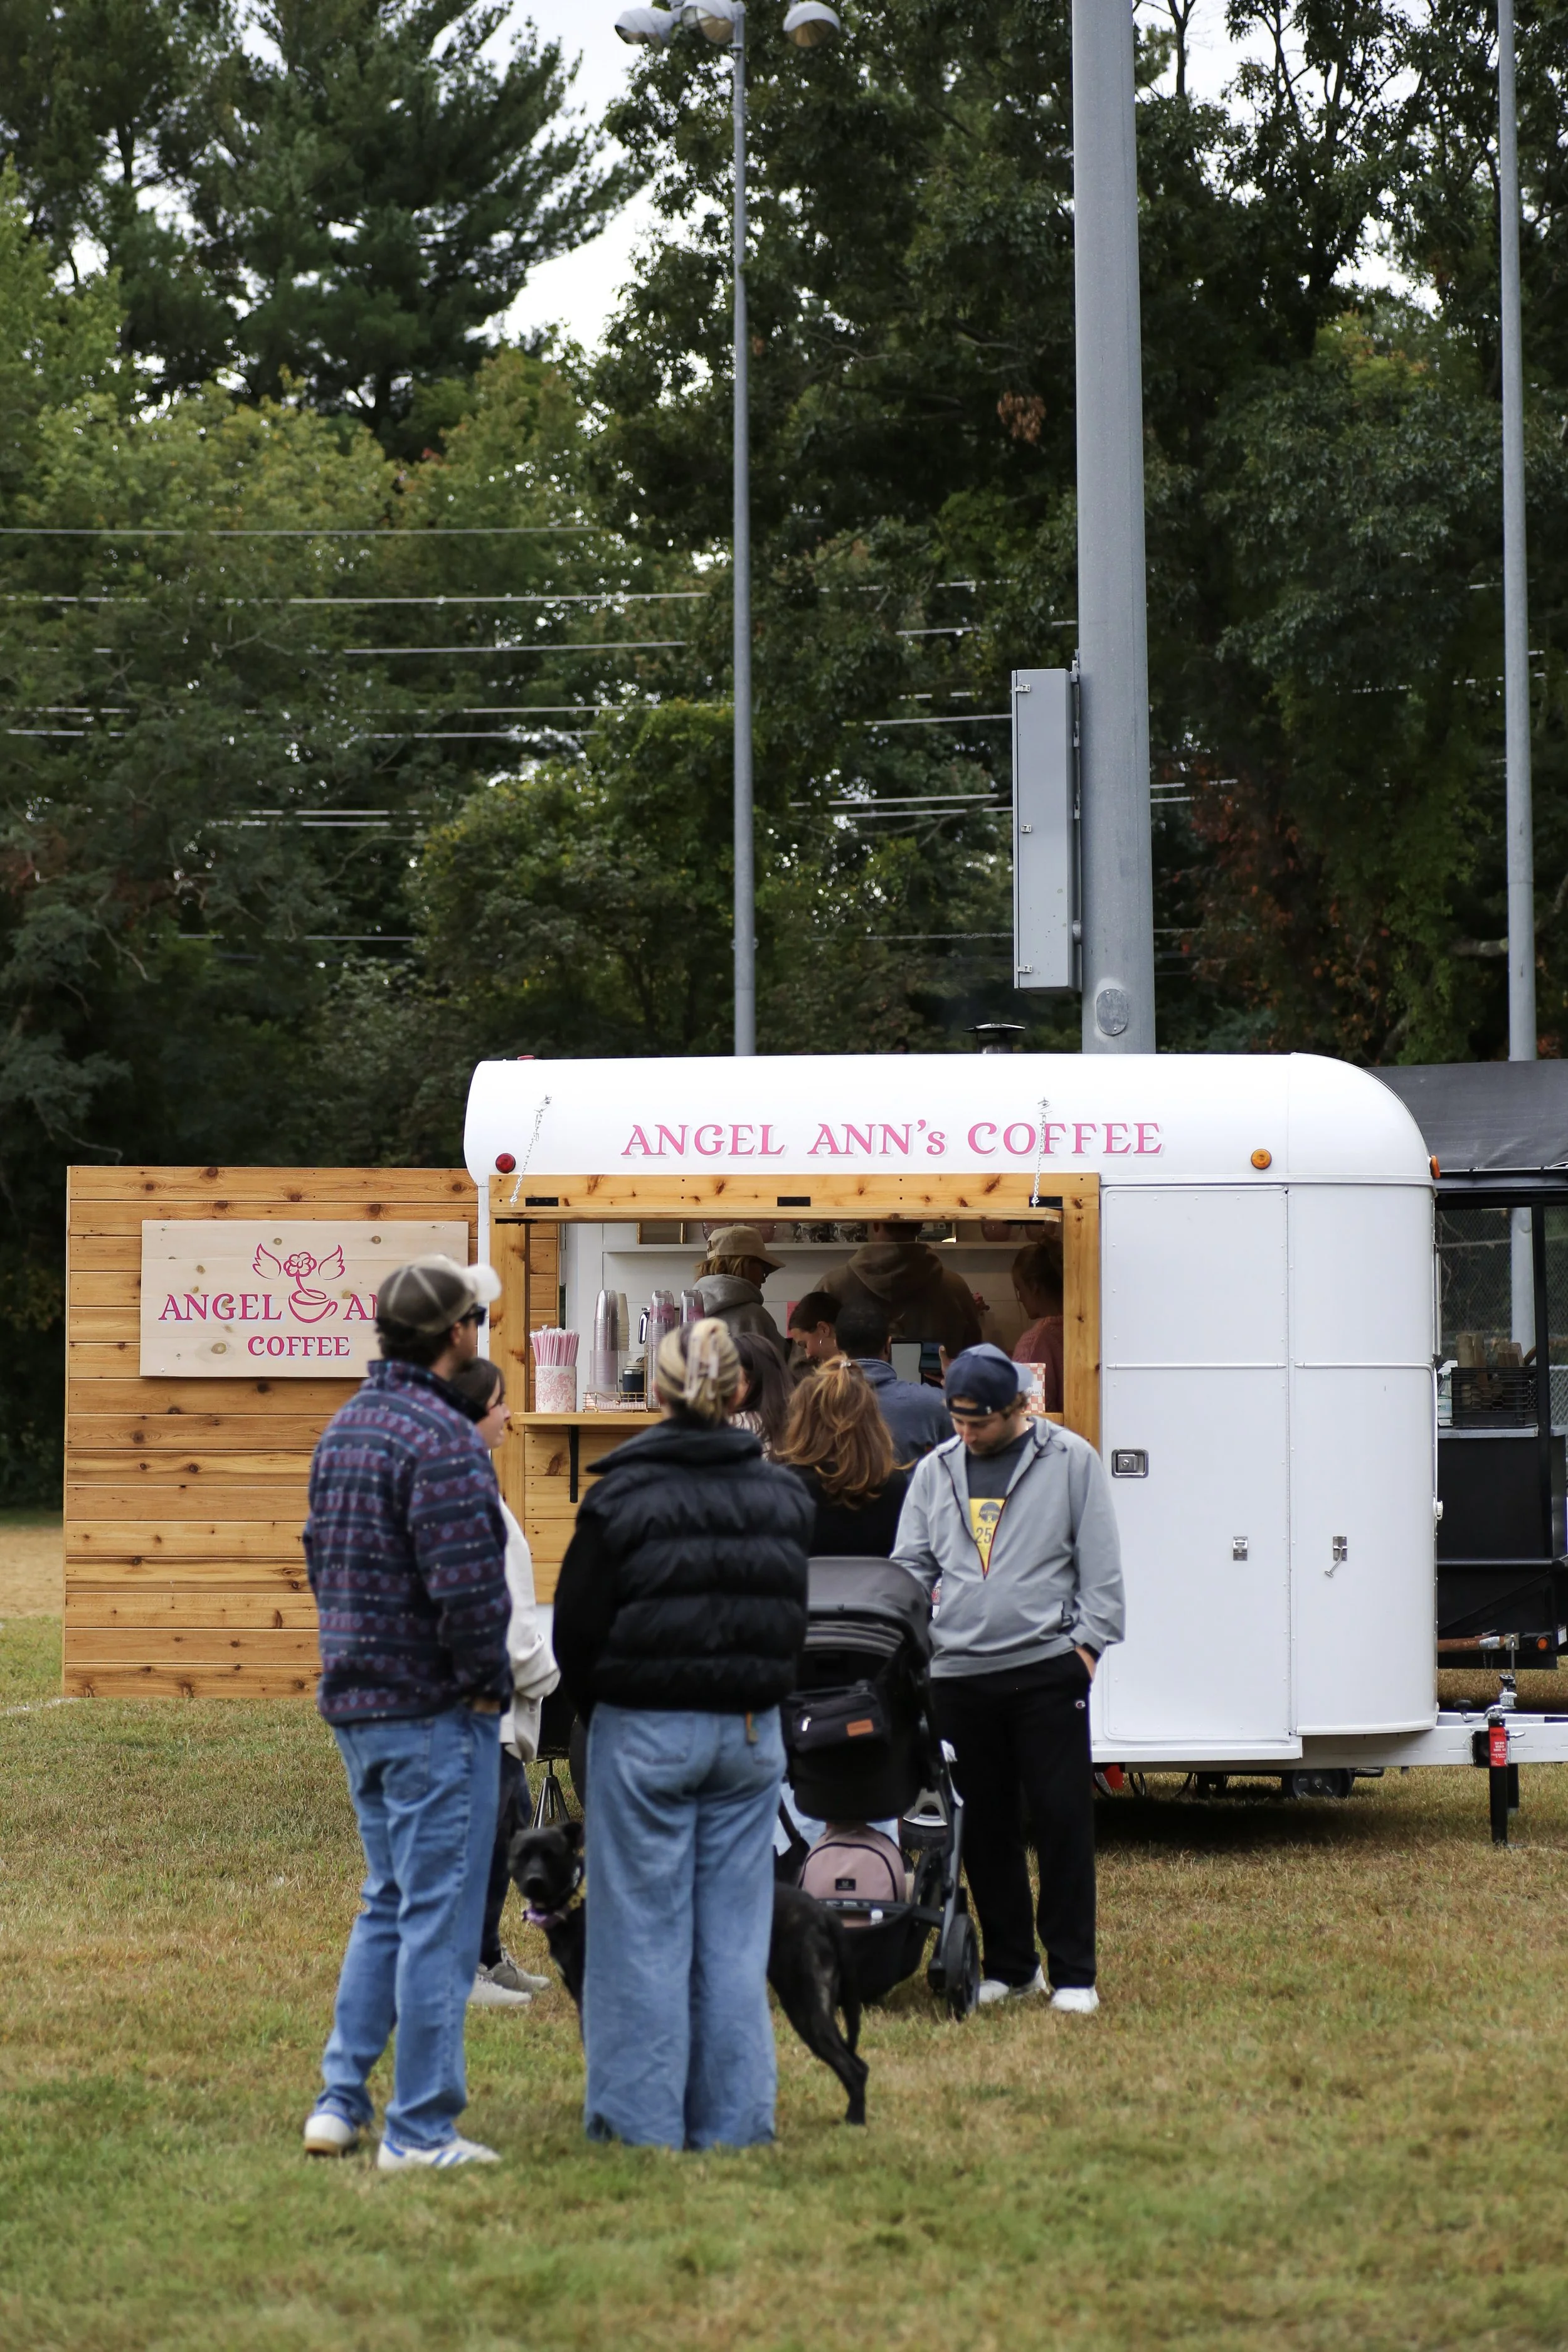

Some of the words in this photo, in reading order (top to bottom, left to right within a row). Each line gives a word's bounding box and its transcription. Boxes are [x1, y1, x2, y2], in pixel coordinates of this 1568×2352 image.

[621, 1125, 785, 1155] ANGEL
[807, 1120, 946, 1155] ANN's
[968, 1122, 1162, 1155] COFFEE
[158, 1293, 282, 1320] ANGEL
[248, 1336, 350, 1356] COFFEE
